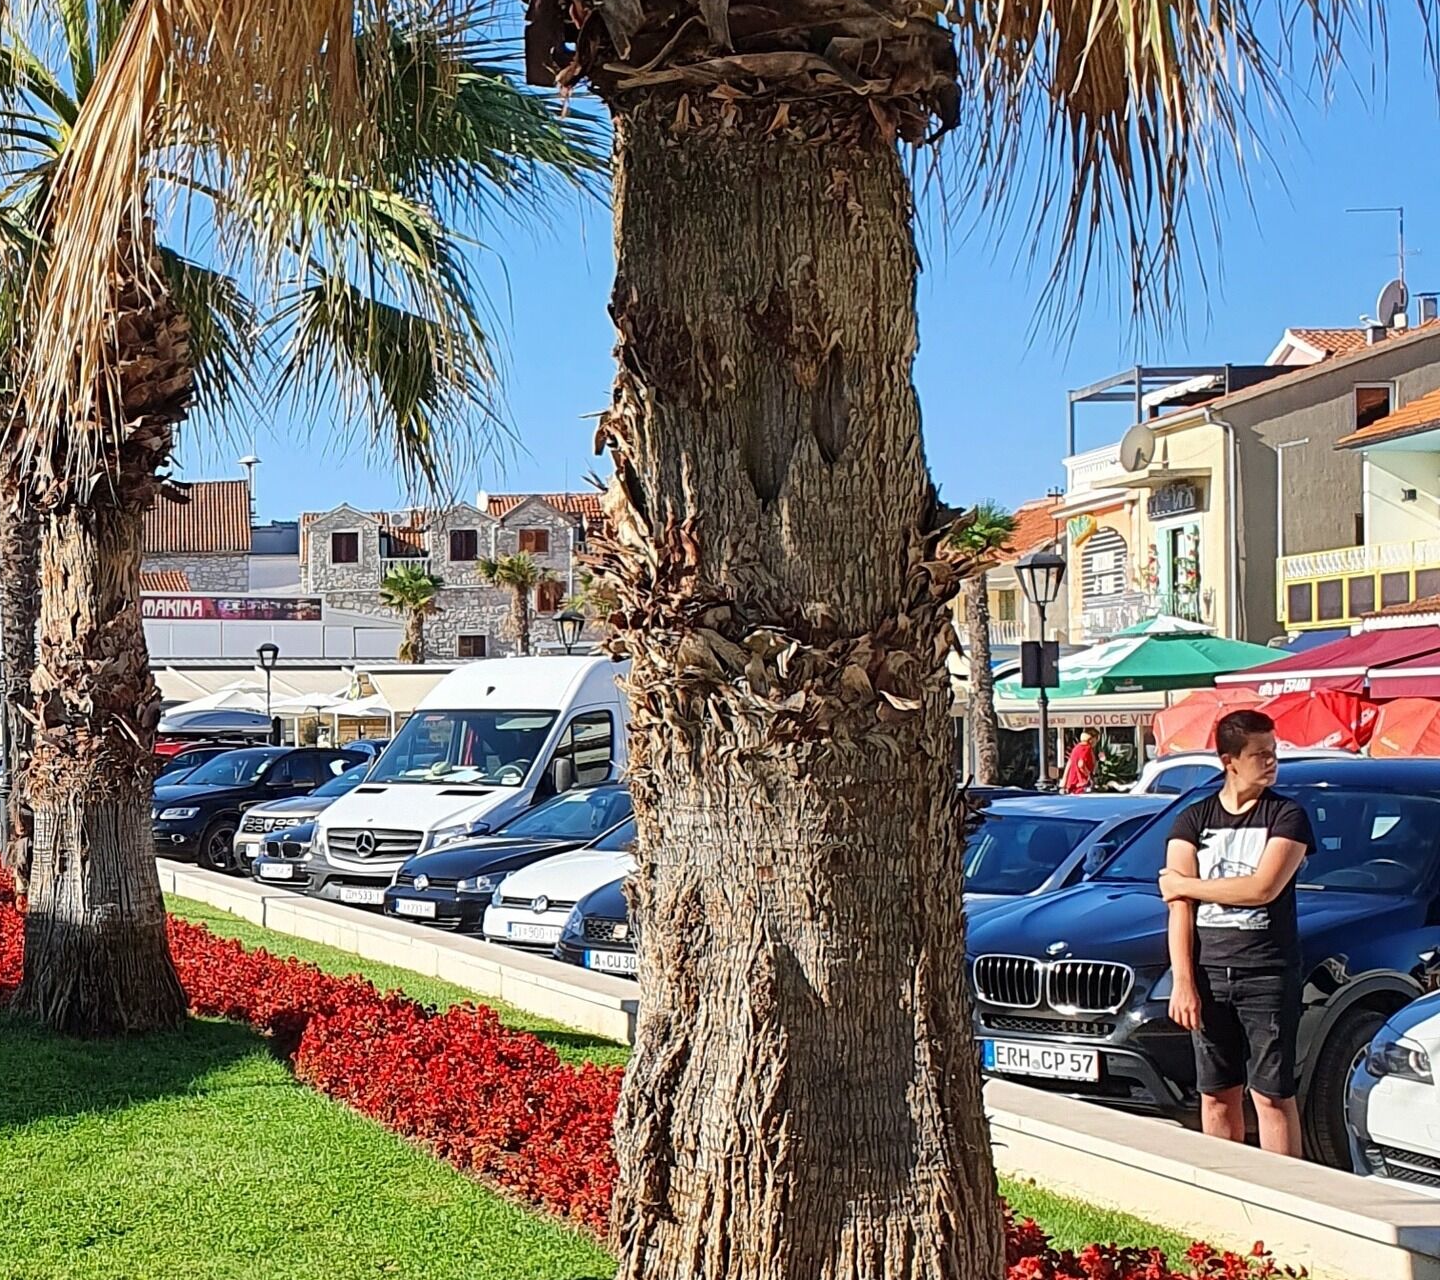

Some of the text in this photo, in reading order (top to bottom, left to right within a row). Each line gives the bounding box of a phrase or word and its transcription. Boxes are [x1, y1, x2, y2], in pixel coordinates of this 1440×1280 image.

[142, 598, 203, 617] MAKINA
[1084, 713, 1127, 726] DOLCE
[594, 953, 601, 966] A
[606, 954, 621, 968] CU
[996, 1045, 1094, 1074] ERH CP 57
